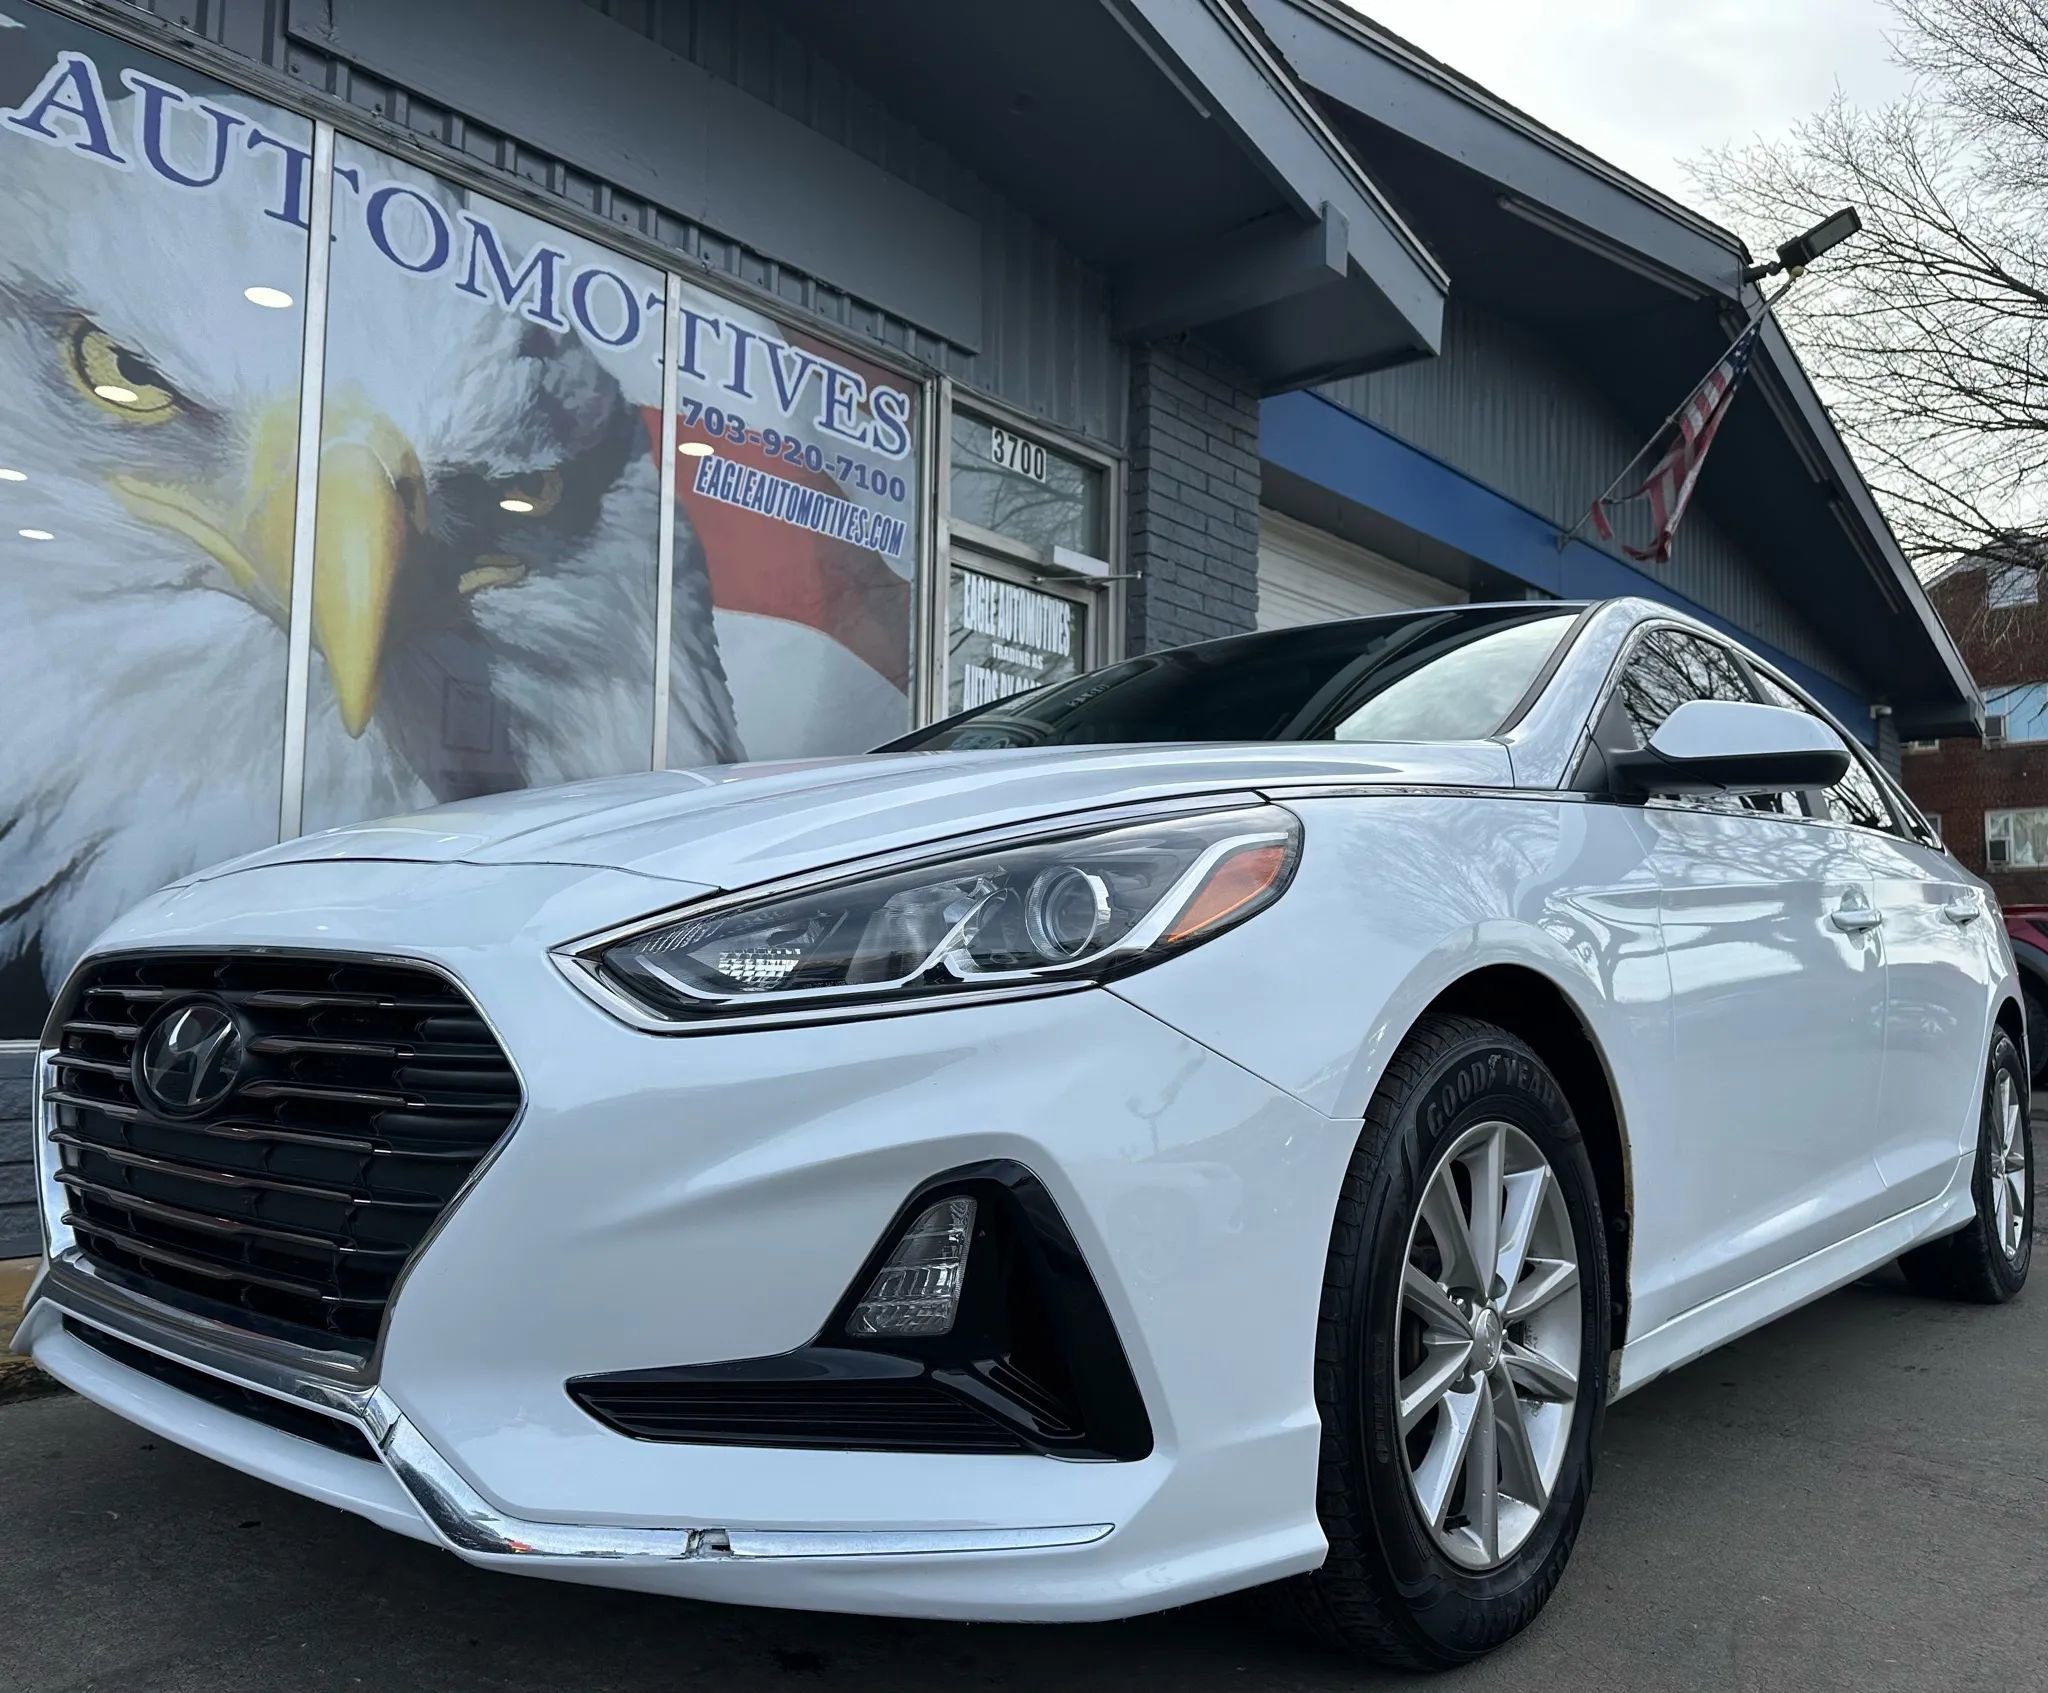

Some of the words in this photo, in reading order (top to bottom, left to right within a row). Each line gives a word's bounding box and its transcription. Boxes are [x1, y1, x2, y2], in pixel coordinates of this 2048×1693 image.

[8, 57, 910, 457] AUTOMOTIVES
[681, 396, 906, 501] 703-920-7100
[993, 429, 1045, 481] 3700
[695, 456, 906, 556] EAGLEAUTOMOTIVES.COM
[963, 572, 999, 638] EAGLE
[997, 582, 1071, 657] AUTOMOTIVES
[991, 643, 1031, 669] TRADING
[1031, 653, 1044, 670] AS
